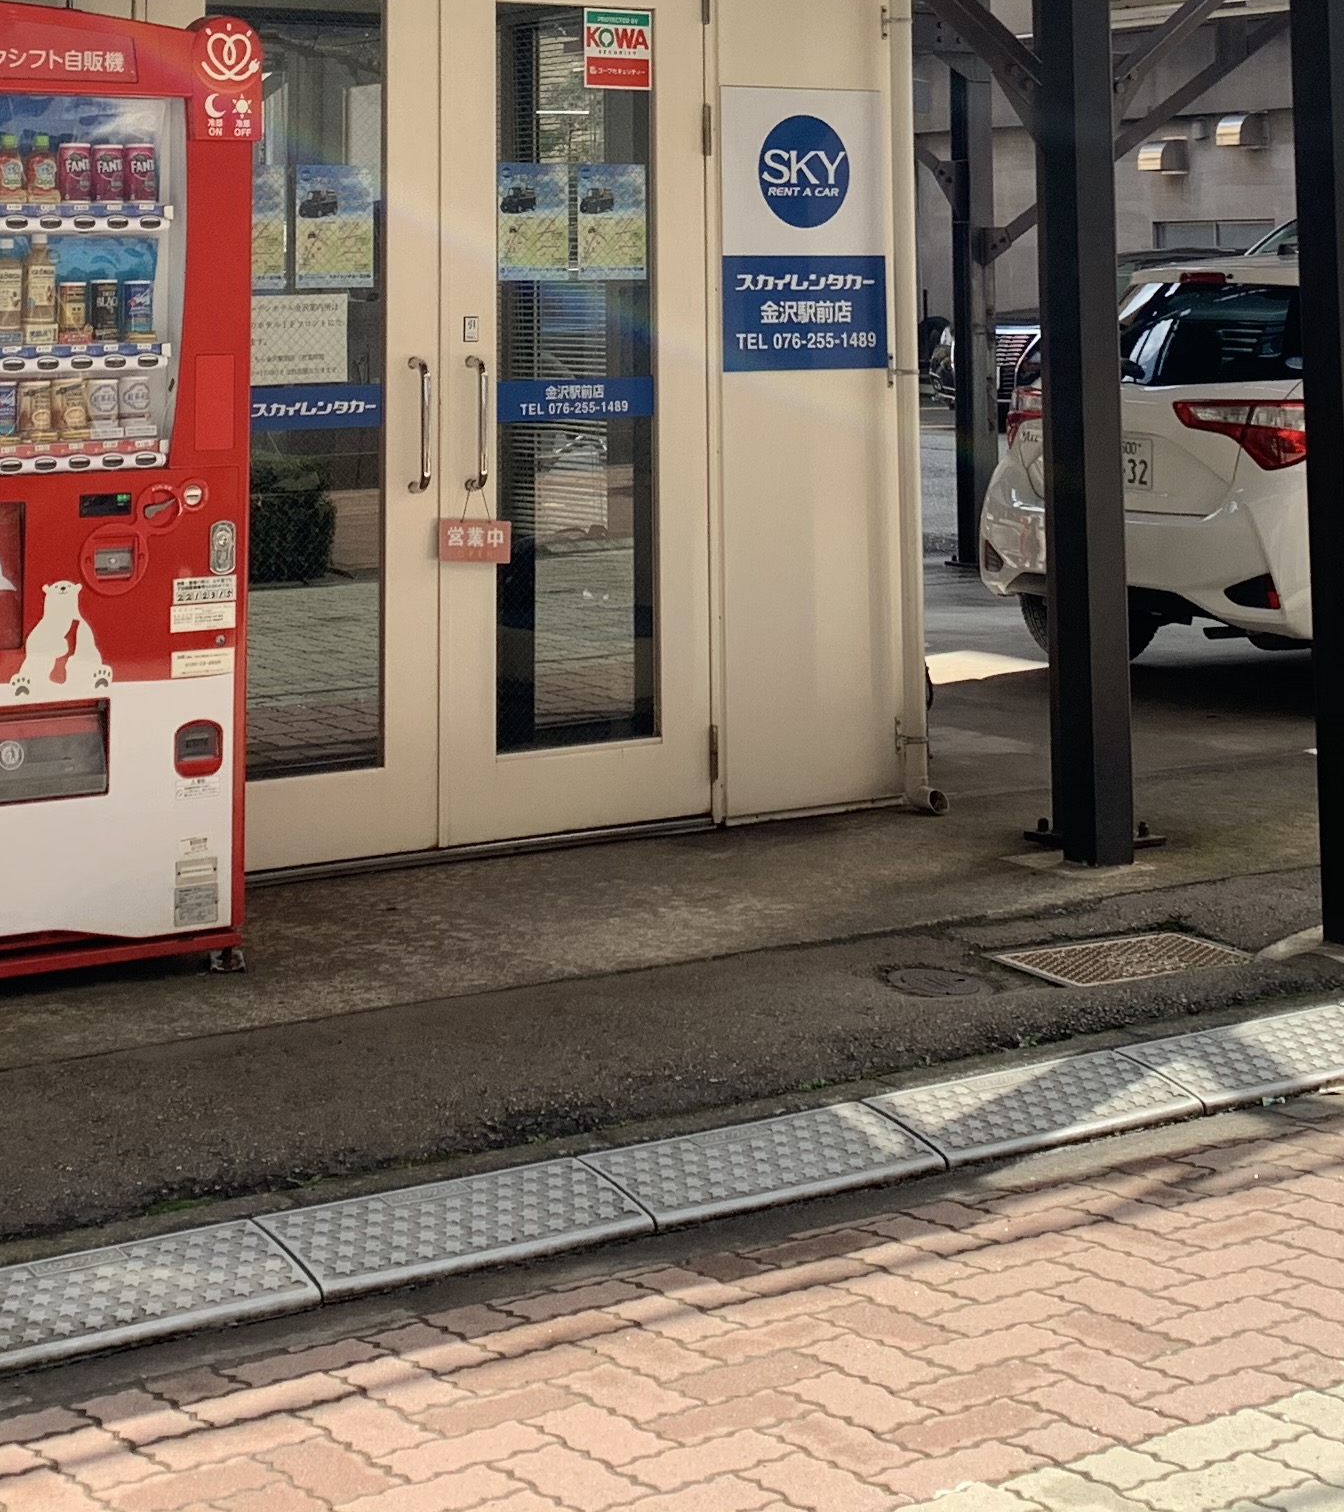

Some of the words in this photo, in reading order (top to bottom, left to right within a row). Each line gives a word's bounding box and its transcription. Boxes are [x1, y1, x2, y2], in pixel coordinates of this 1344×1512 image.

[586, 26, 649, 50] KOWA
[208, 127, 223, 137] ON
[233, 128, 252, 137] OFF
[762, 148, 846, 185] SKY
[768, 187, 800, 197] RENT
[802, 187, 812, 196] A
[814, 187, 839, 197] CAR
[735, 273, 876, 292] スカイレンタカー
[760, 300, 852, 324] 金沢駅前店
[736, 333, 768, 350] TEL
[773, 331, 877, 349] 076-255-1489
[545, 384, 605, 400] 金沢駅前店
[250, 398, 377, 418] スカイレンタカー
[520, 403, 545, 416] TEL
[548, 400, 629, 415] 076-255-1489
[1122, 458, 1149, 486] 32
[447, 525, 505, 548] 営業中
